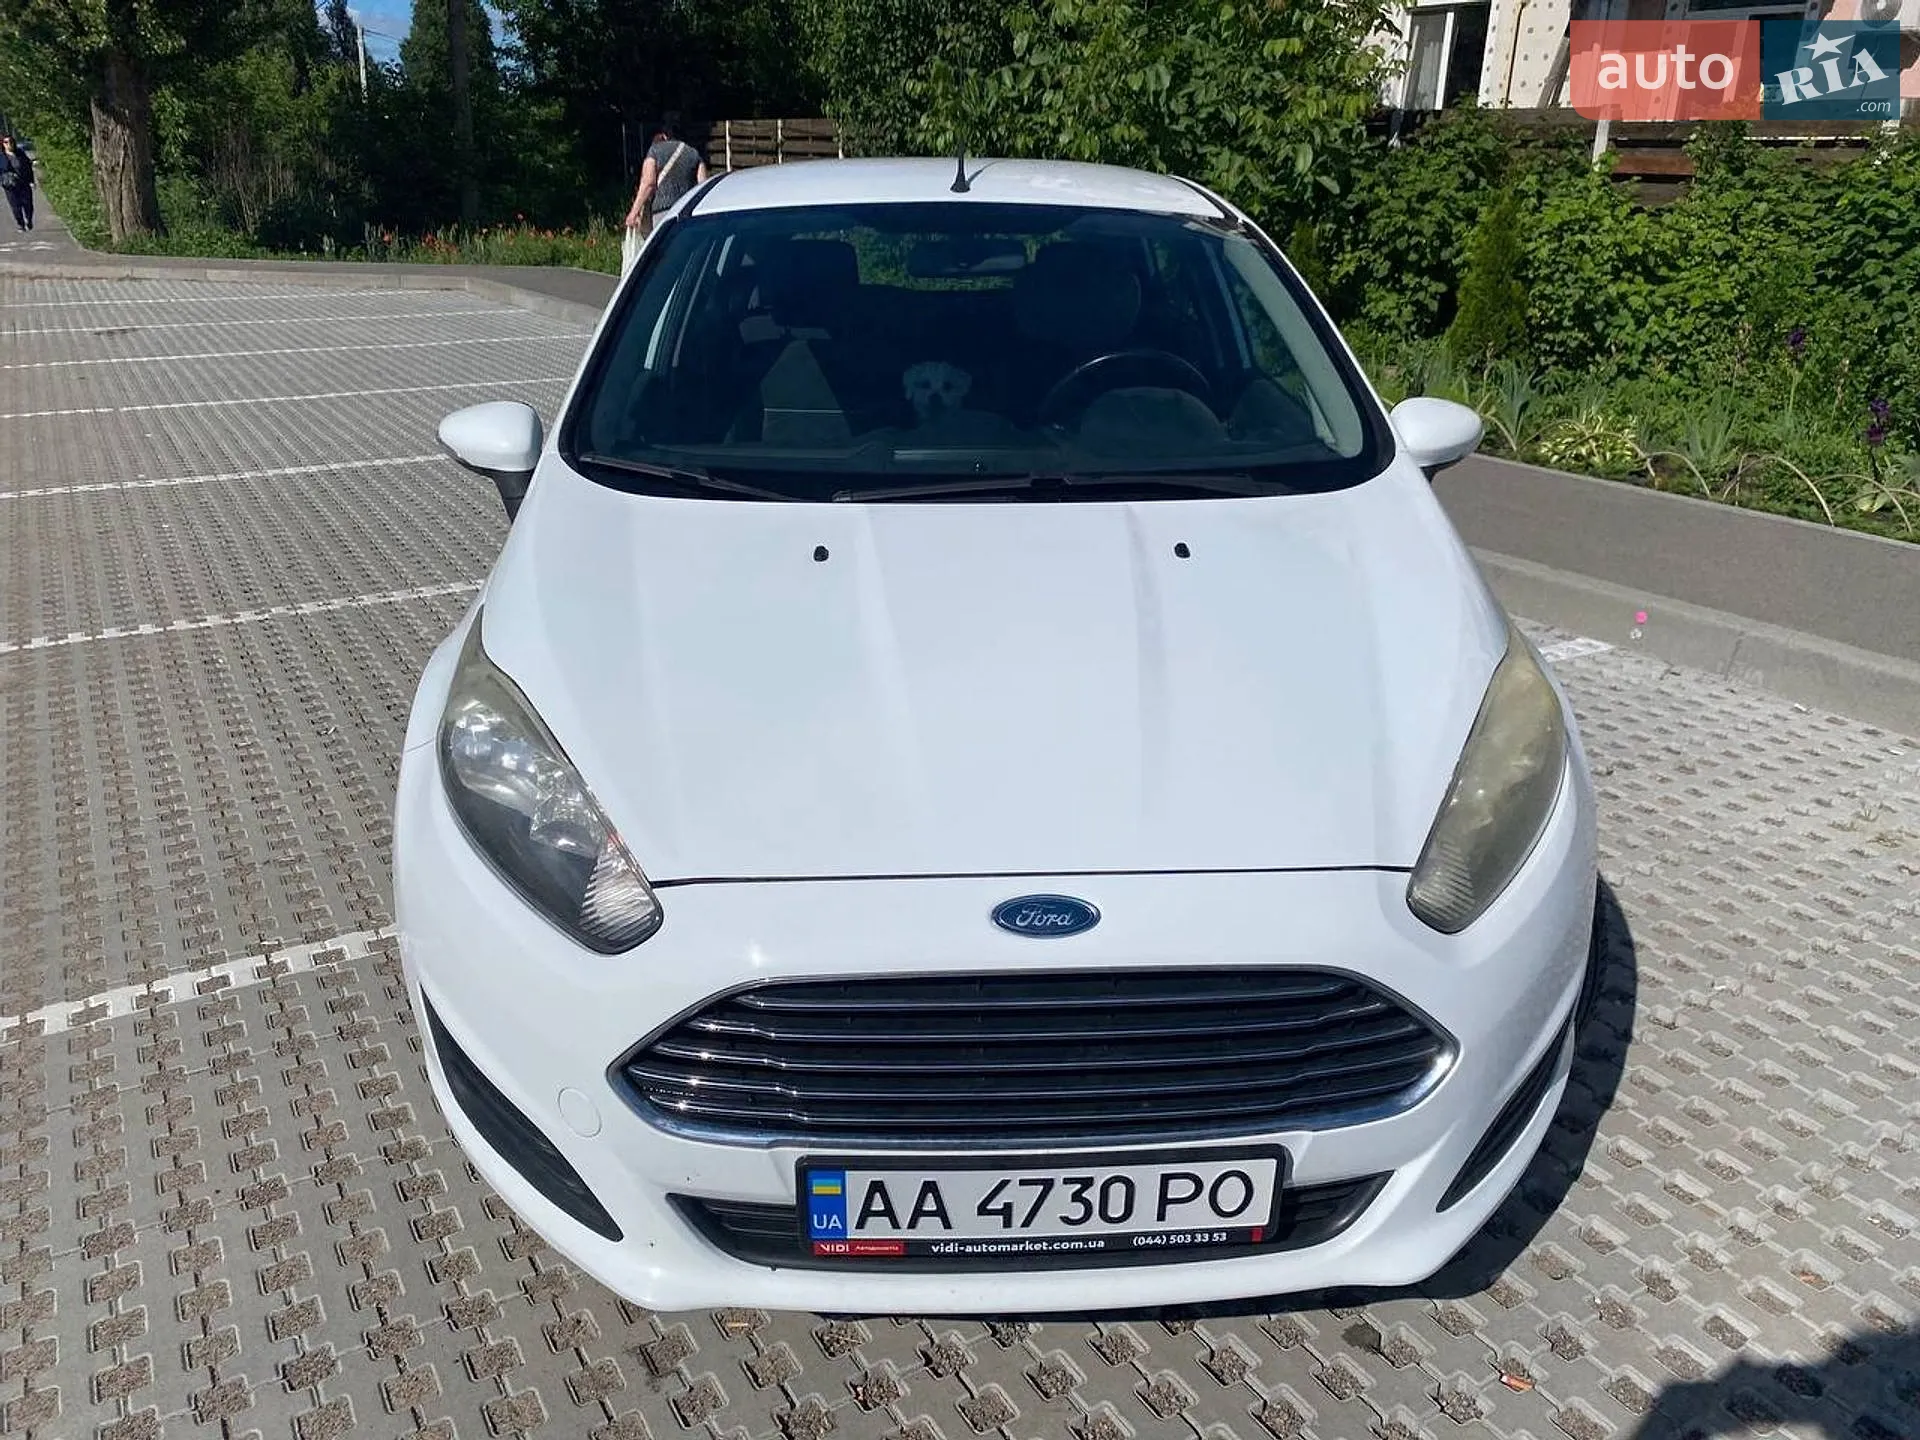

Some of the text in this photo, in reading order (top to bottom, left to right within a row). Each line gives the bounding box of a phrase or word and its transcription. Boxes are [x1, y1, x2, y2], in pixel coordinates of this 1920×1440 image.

[1016, 902, 1074, 927] Ford
[855, 1169, 1255, 1230] AA 4730 PO
[813, 1213, 843, 1230] UA
[1133, 1232, 1227, 1246] (044) 503 33 53
[820, 1243, 850, 1253] VIDI
[931, 1240, 1105, 1254] vidi-automarket.com.ua
